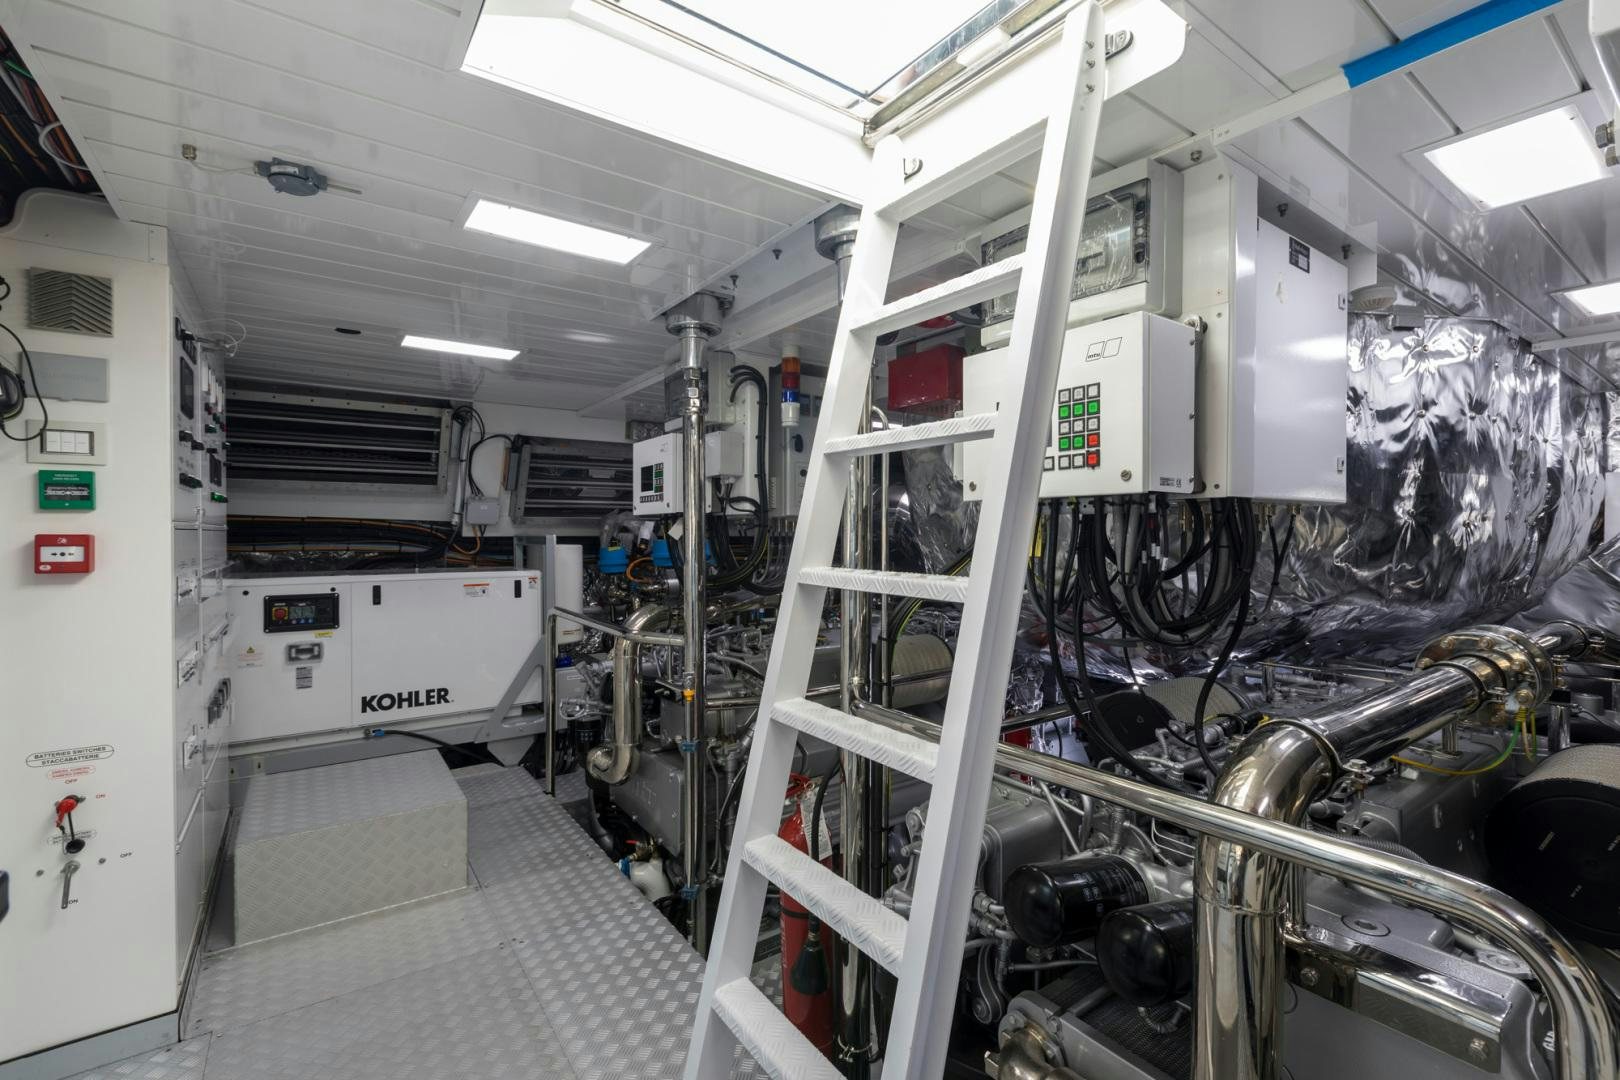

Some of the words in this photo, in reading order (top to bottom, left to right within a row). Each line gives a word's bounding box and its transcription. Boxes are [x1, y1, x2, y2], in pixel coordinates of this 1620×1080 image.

[361, 688, 450, 713] KOHLER
[34, 750, 71, 760] BATTERIES
[73, 746, 106, 755] SWITCHES
[41, 753, 99, 766] STACCABATTERIE
